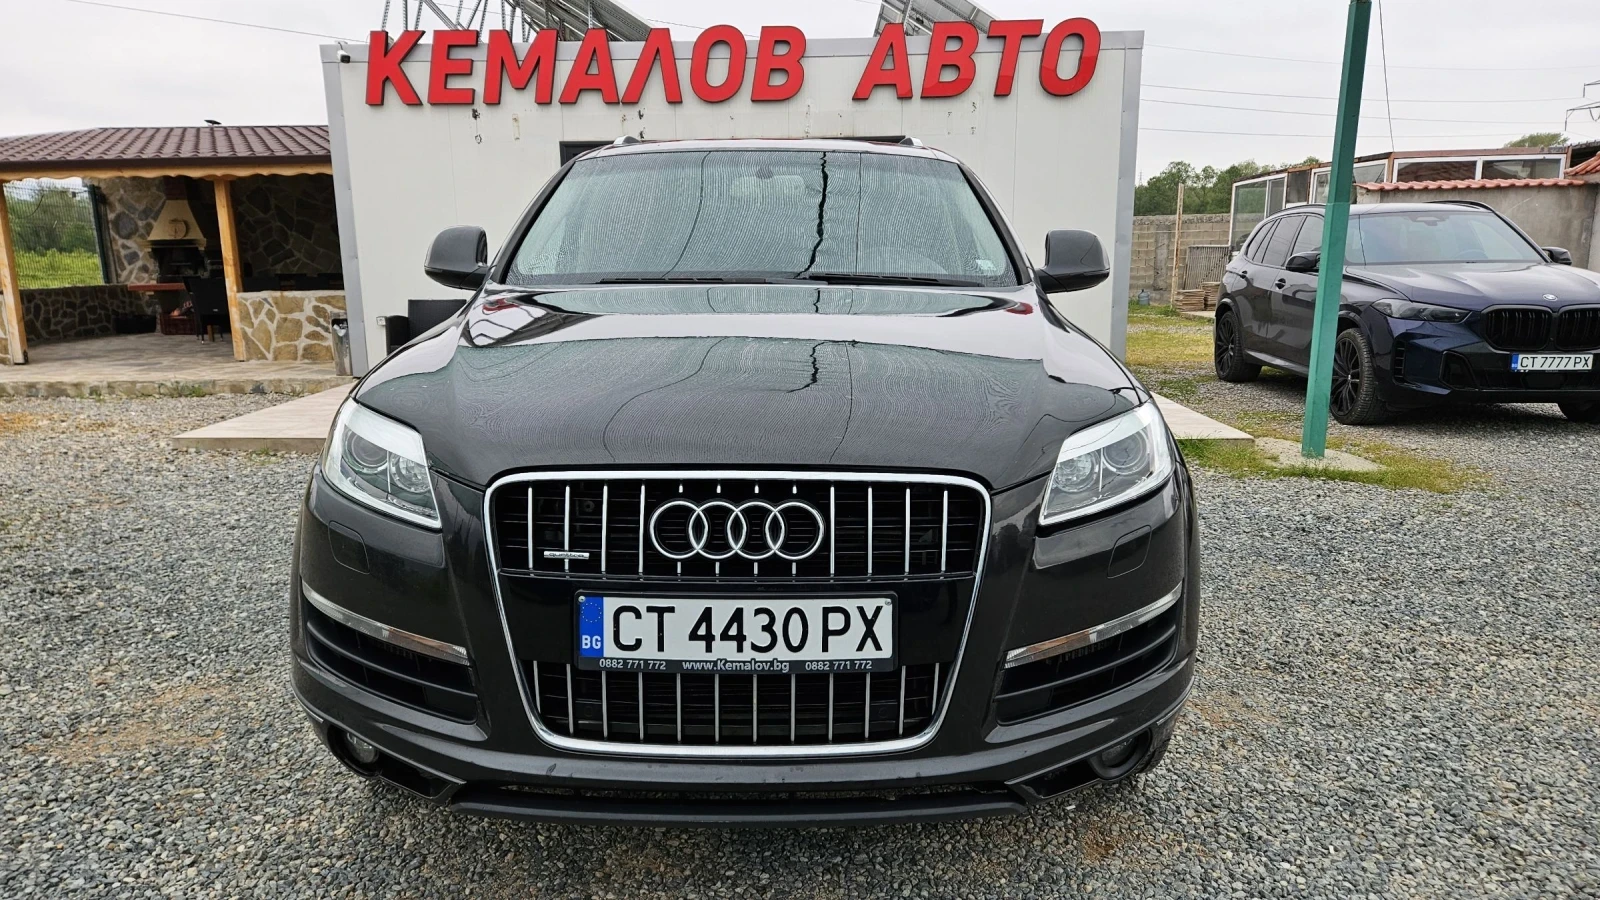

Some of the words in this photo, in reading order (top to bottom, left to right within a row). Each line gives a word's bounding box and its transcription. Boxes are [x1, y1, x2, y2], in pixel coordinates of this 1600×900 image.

[365, 25, 807, 105] КЕМАЛОВ
[852, 17, 1101, 99] АВТО
[1520, 356, 1538, 368] CT
[1540, 356, 1572, 368] 7777
[1573, 356, 1591, 368] PX
[612, 605, 676, 653] CT
[688, 606, 809, 654] 4430
[821, 605, 884, 653] PX
[581, 635, 602, 649] BG
[599, 658, 624, 668] 0882
[626, 659, 644, 669] 771
[647, 660, 667, 670] 772
[682, 659, 790, 673] www.Kemalov.bg
[805, 661, 830, 671] 0882
[833, 661, 851, 670] 771
[854, 660, 873, 669] 772
